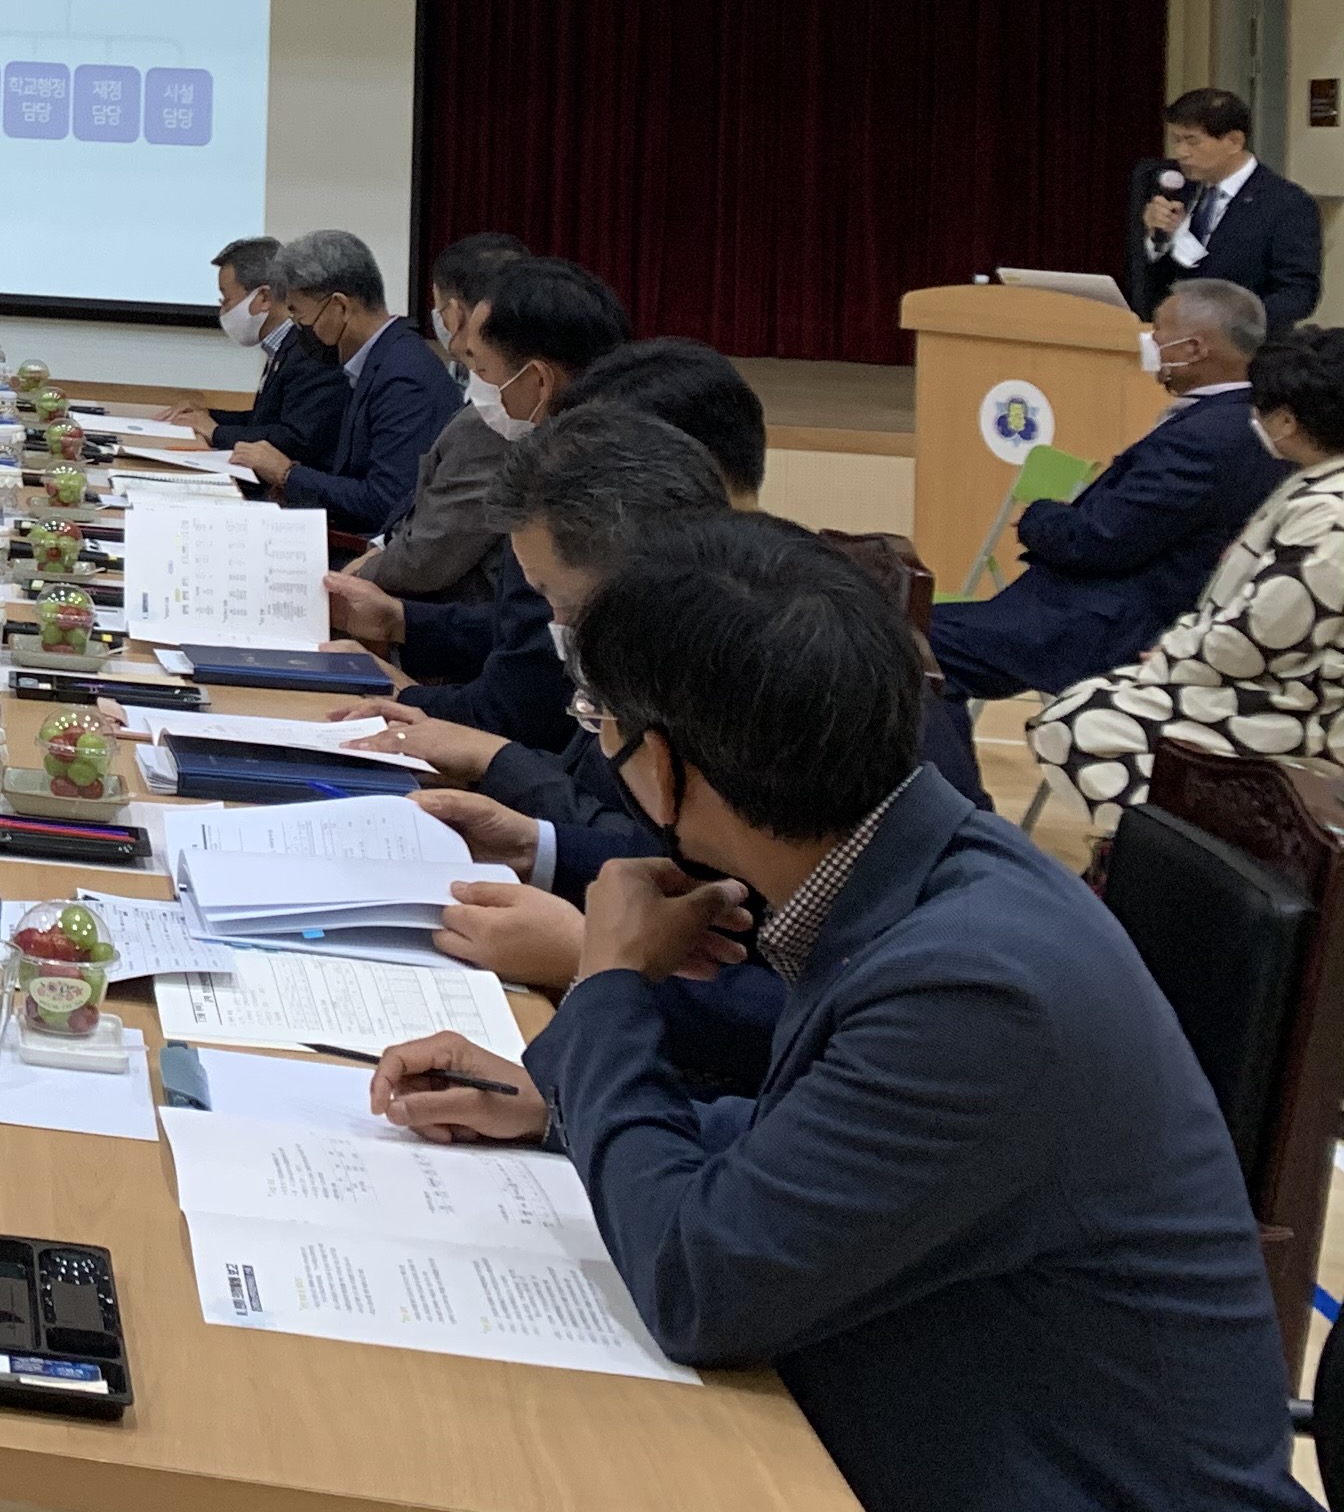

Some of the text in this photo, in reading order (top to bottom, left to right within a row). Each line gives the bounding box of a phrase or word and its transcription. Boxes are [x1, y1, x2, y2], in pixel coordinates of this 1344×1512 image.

[22, 102, 53, 123] 담당
[92, 105, 122, 126] 담당
[163, 108, 194, 129] 담당
